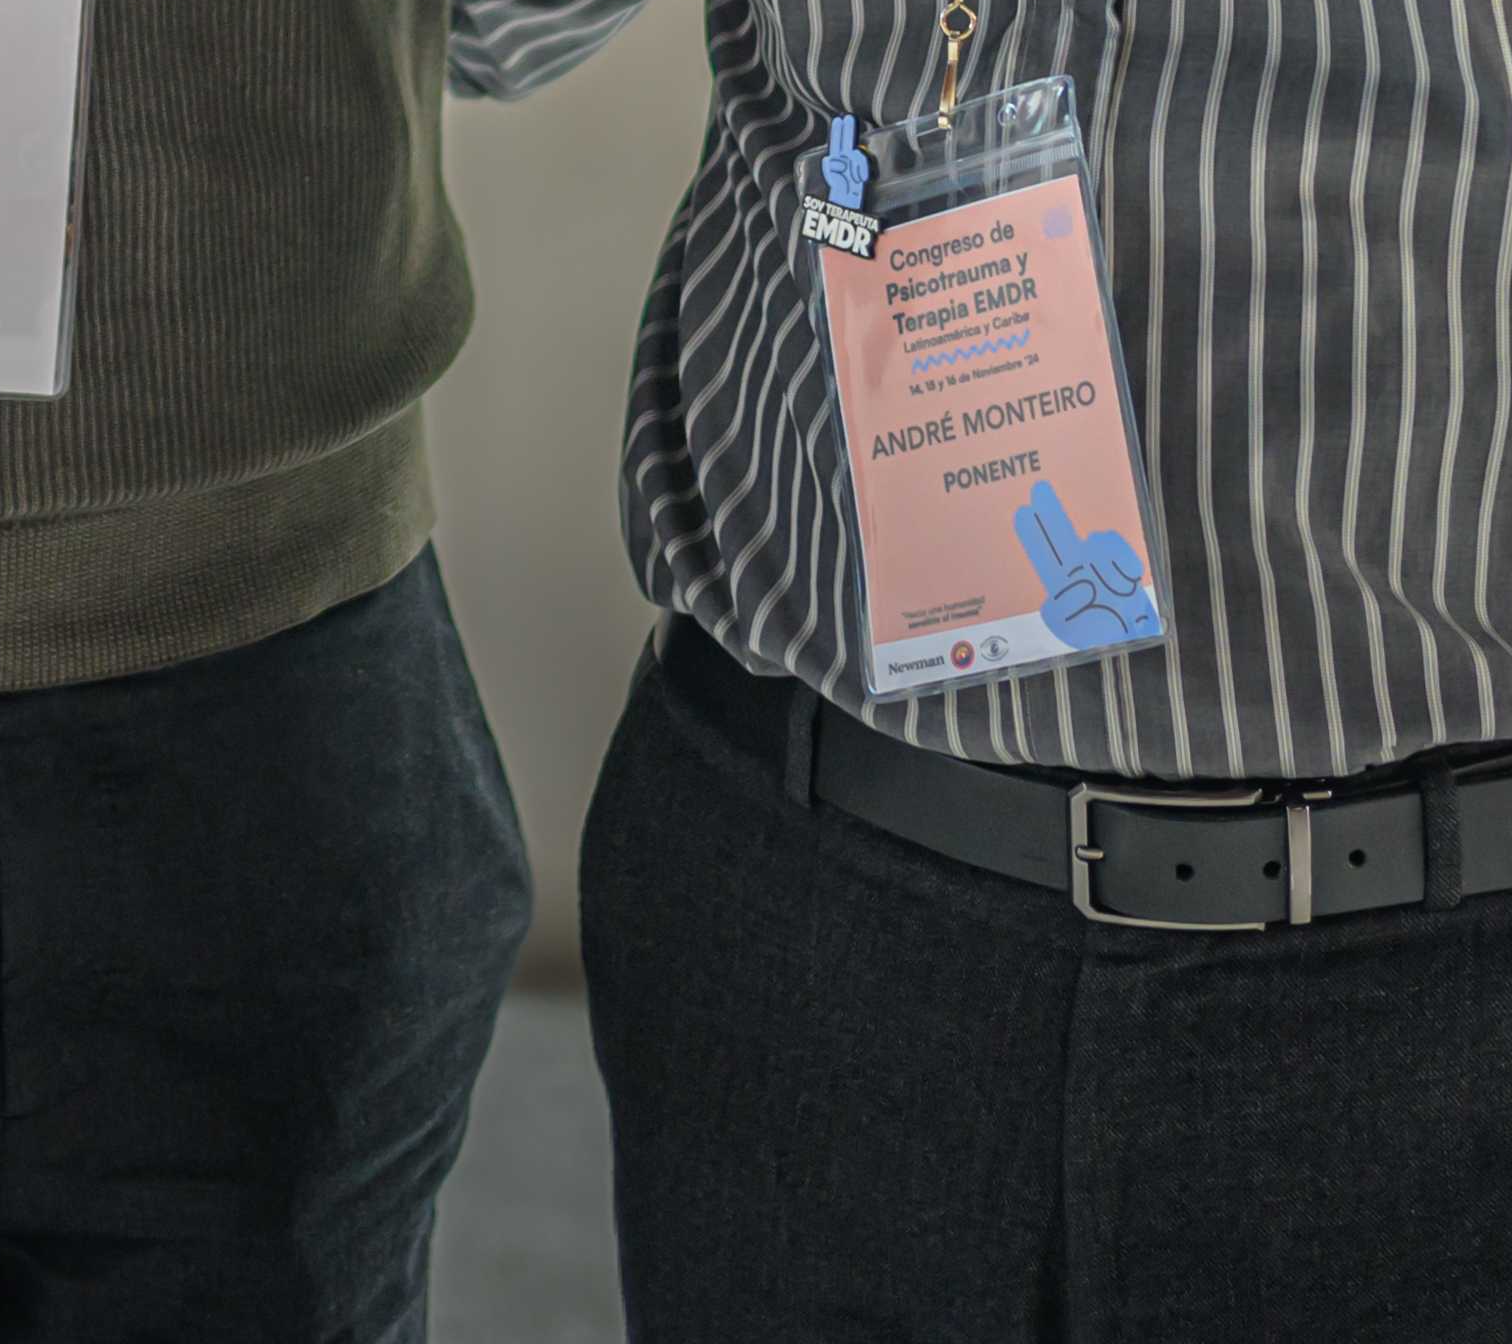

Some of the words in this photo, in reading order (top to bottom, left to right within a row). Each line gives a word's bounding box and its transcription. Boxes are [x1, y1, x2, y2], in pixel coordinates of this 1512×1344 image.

[802, 209, 871, 257] EMDR
[803, 195, 826, 212] SOY
[826, 202, 879, 233] TERAPEUTA
[889, 232, 984, 272] Congreso
[990, 220, 1015, 243] de
[886, 257, 1012, 306] Psicotrauma
[1016, 251, 1029, 276] y
[892, 299, 969, 335] Terapia
[973, 278, 1038, 314] EMDR
[904, 324, 981, 354] Latinoamérica
[992, 312, 1030, 330] Caribe
[958, 371, 971, 384] de
[972, 359, 1023, 380] Noviembre
[872, 410, 957, 461] ANDRÉ
[962, 380, 1097, 437] MONTEIRO
[943, 449, 1042, 493] PONENTE
[888, 654, 945, 676] Newman
